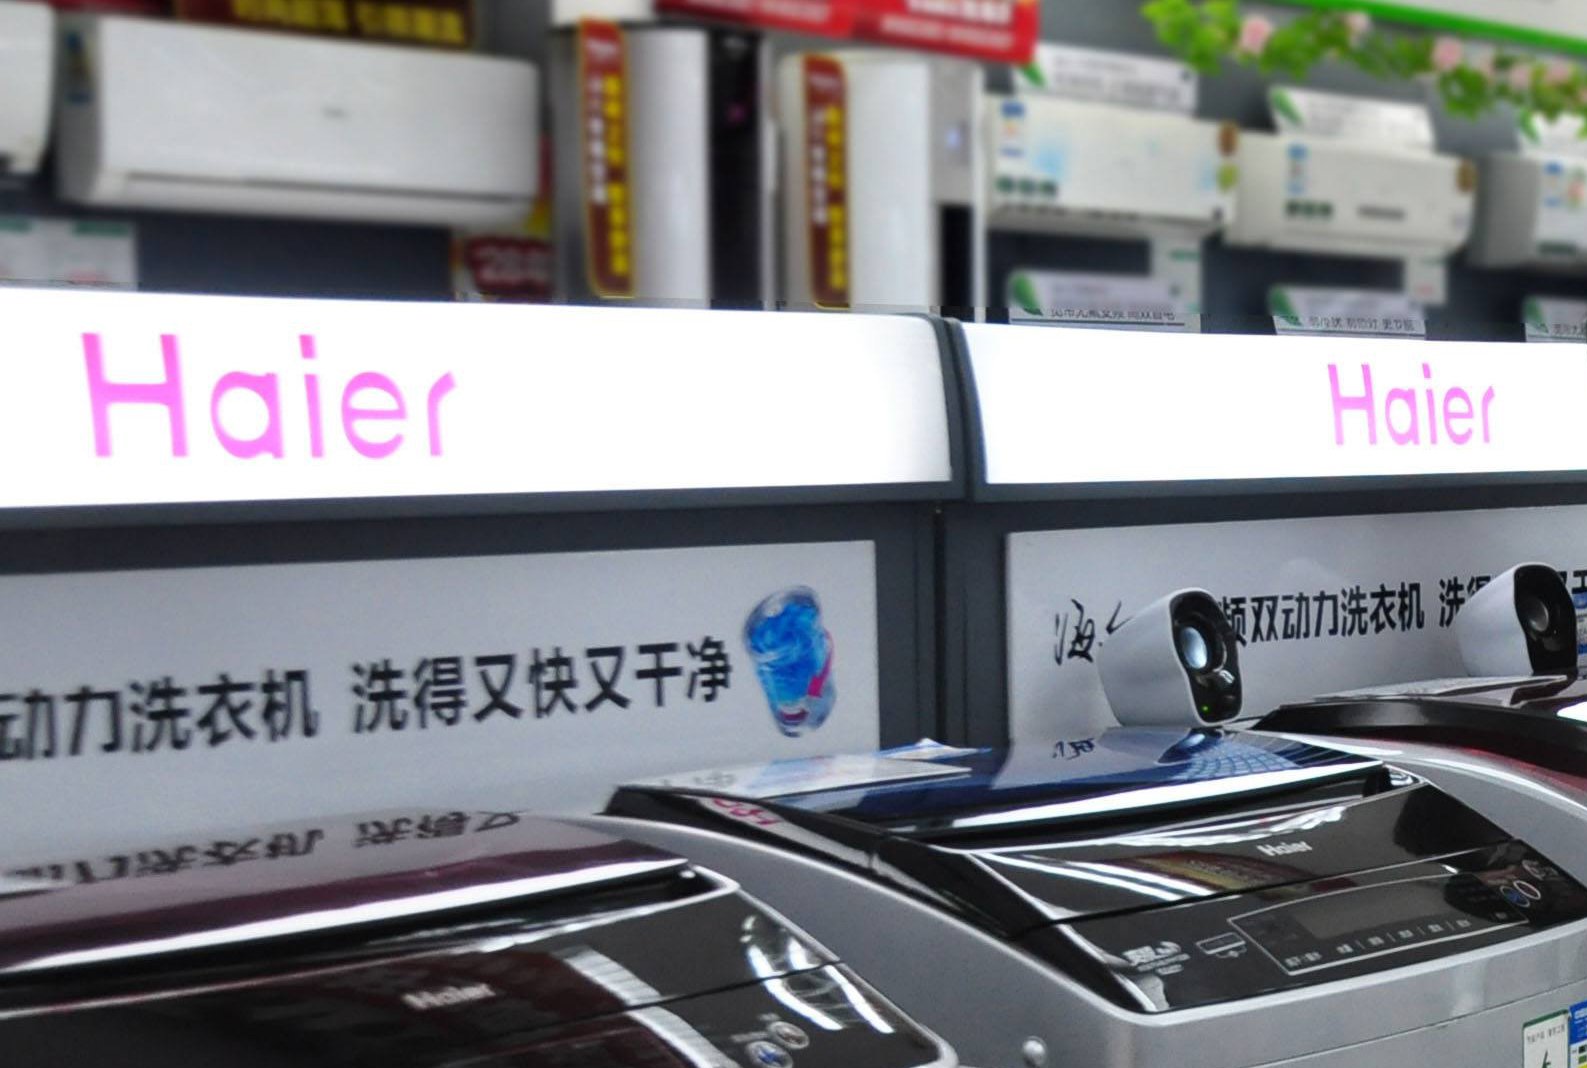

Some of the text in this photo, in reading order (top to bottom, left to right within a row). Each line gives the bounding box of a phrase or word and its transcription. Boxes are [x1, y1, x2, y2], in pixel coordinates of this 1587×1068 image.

[82, 332, 457, 458] Haier
[1327, 362, 1496, 446] Haier
[351, 635, 733, 734] 洗得又快又干净
[1256, 841, 1313, 856] Haier
